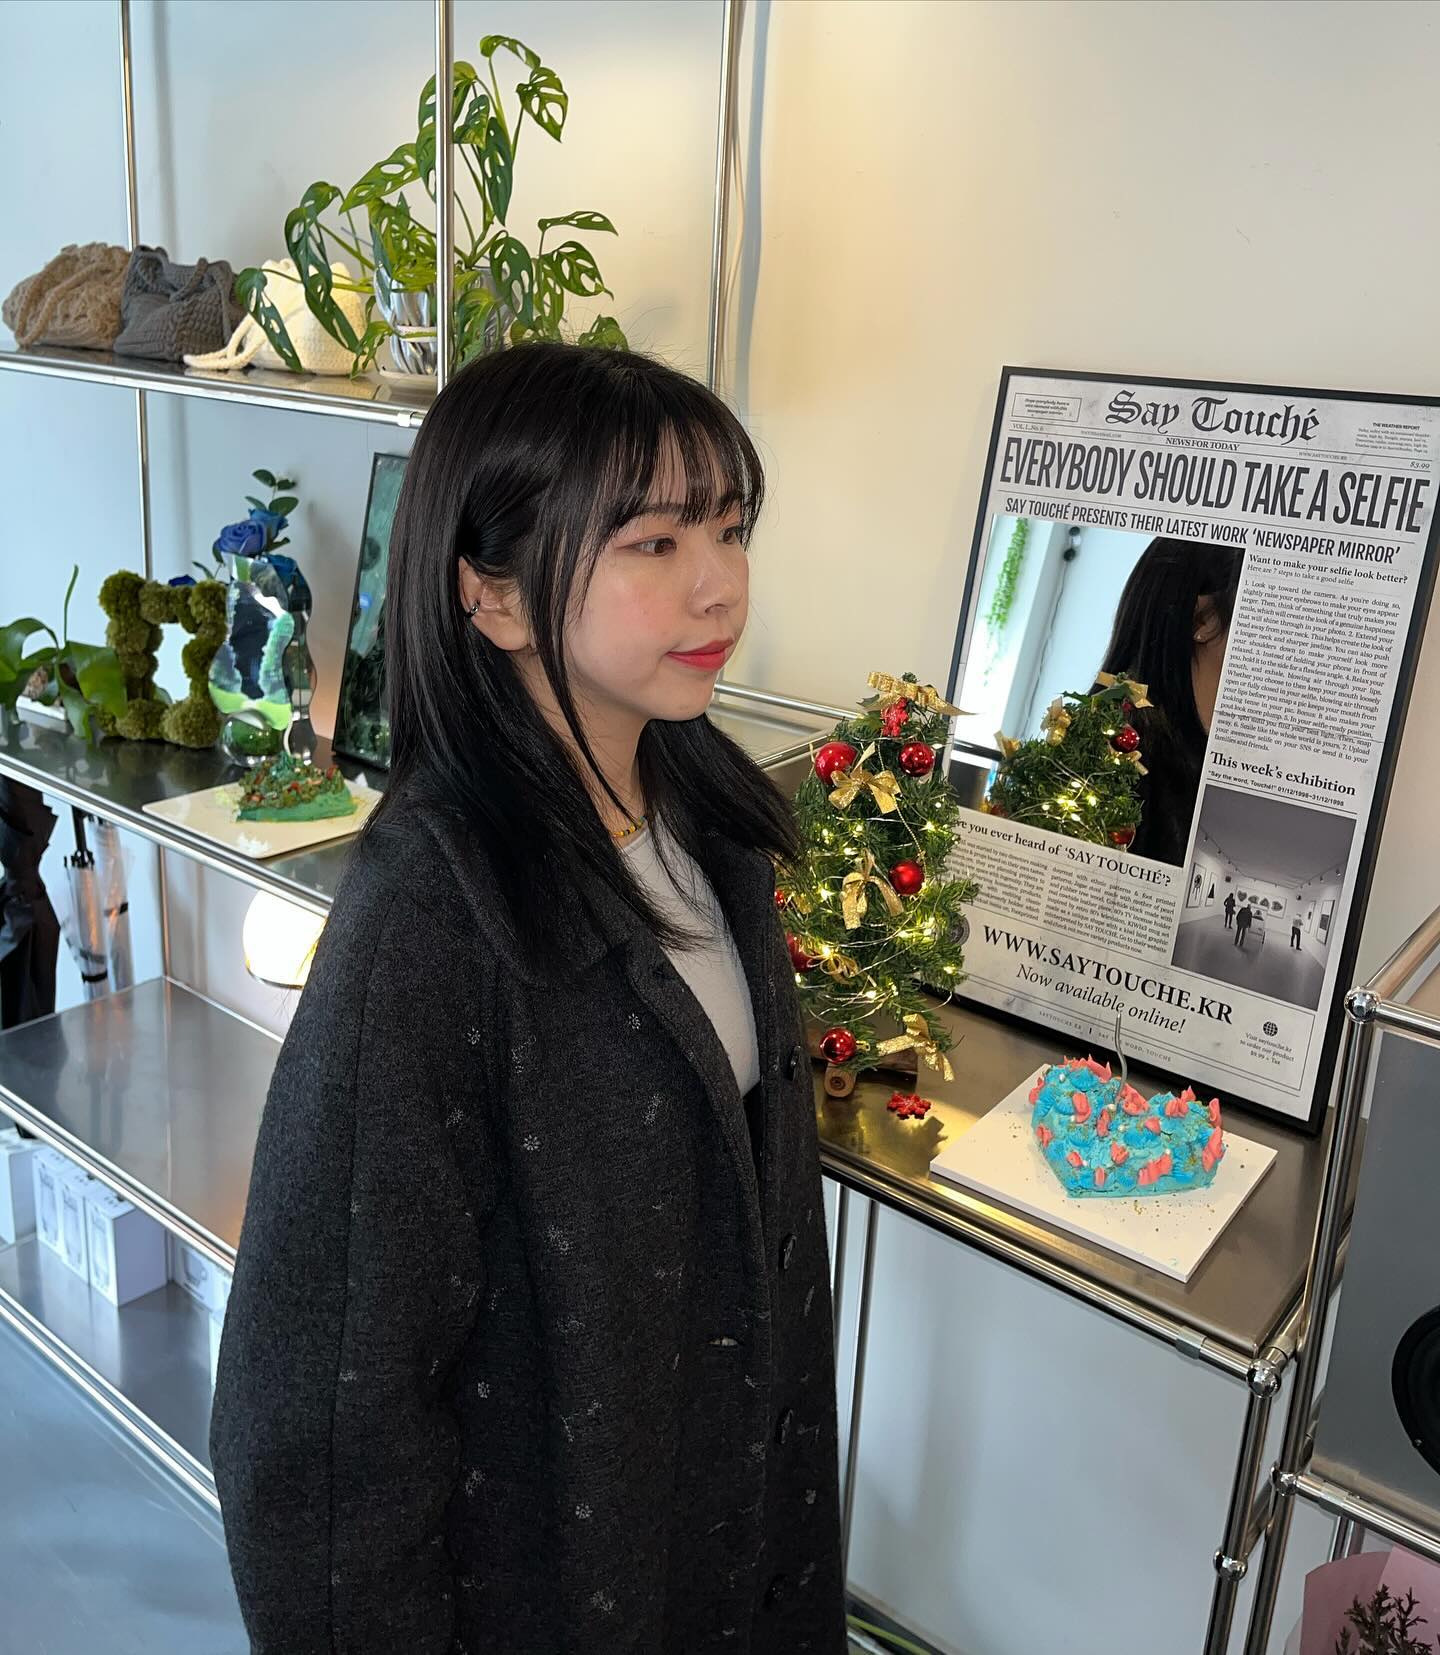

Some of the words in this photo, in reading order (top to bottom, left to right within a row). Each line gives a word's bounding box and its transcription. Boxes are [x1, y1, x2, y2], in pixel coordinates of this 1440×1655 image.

[1105, 390, 1180, 434] Say
[1191, 397, 1320, 445] Touché
[1166, 437, 1191, 446] NEWS
[1191, 440, 1209, 448] FOR
[1210, 442, 1240, 451] TODAY
[1000, 437, 1136, 496] EVERYBODY
[1134, 450, 1237, 509] SHOULD
[1241, 461, 1310, 519] TAKE
[1306, 469, 1329, 522] A
[1333, 471, 1430, 533] SELFIE
[1005, 498, 1027, 514] SAY
[1029, 500, 1071, 520] TOUCHÉ
[1071, 506, 1128, 527] PRESENTS
[1131, 513, 1164, 532] THEIR
[1166, 518, 1209, 538] LATEST
[1211, 523, 1249, 544] WORK
[1252, 528, 1335, 556] ‘NEWSPAPER
[1337, 541, 1400, 564] MIRROR’
[1247, 564, 1262, 572] Here
[1278, 570, 1293, 578] steps
[1338, 578, 1354, 586] selfie
[1249, 554, 1271, 564] Want
[1273, 558, 1281, 566] to
[1283, 560, 1306, 569] make
[1330, 566, 1352, 576] selfie
[1354, 568, 1374, 579] look
[1376, 572, 1408, 584] better?
[1210, 751, 1238, 768] This
[1241, 763, 1282, 778] week’s
[1286, 772, 1355, 796] exhibition
[968, 824, 988, 835] you
[990, 830, 1013, 841] ever
[1015, 833, 1046, 851] heard
[1048, 844, 1062, 855] of
[1065, 847, 1095, 864] ‘SAY
[1096, 855, 1171, 887] TOUCHÉ’?
[984, 925, 1232, 1025] WWW.SAYTOUCHE.KR
[1016, 964, 1052, 987] Now
[1055, 982, 1125, 1015] available
[1128, 1007, 1186, 1033] online!
